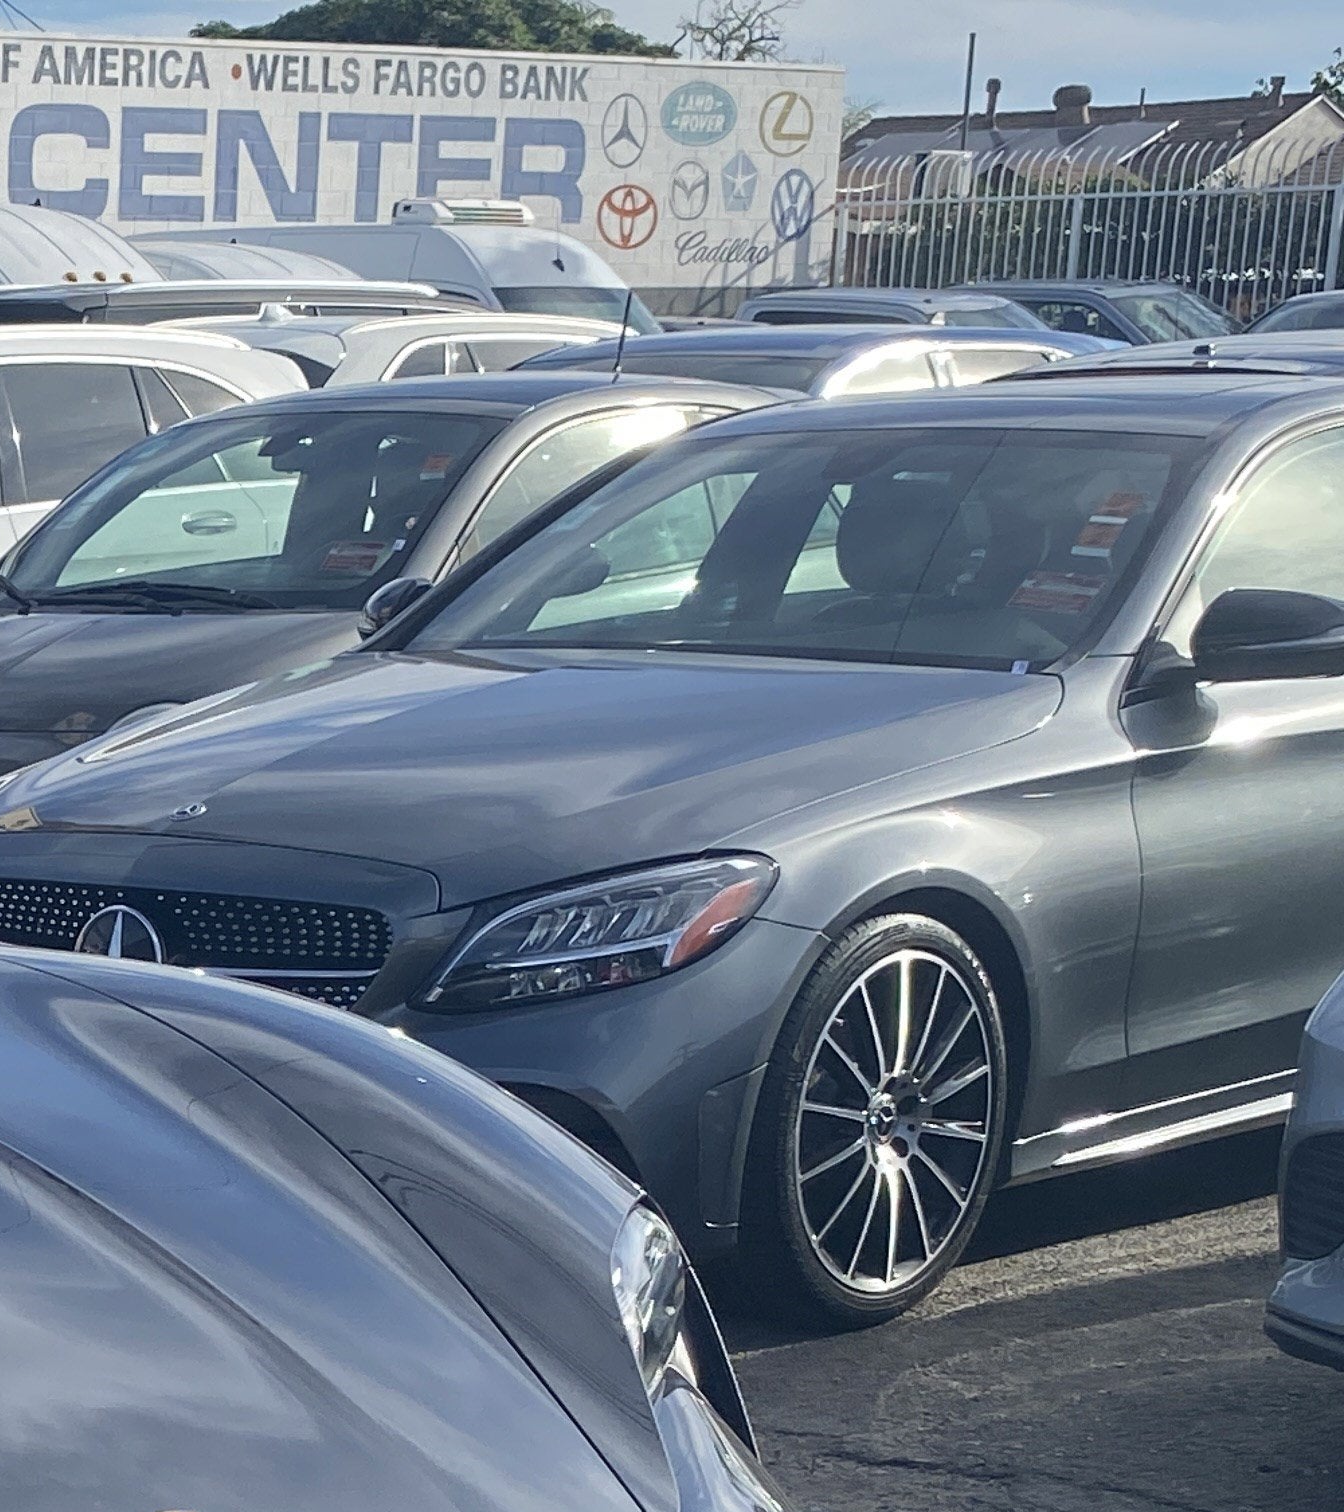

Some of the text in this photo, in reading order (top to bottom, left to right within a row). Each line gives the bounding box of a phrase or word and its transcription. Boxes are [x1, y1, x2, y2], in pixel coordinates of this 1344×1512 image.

[31, 45, 210, 90] AMERICA
[246, 53, 591, 103] WELLS FARGO BANK
[8, 103, 586, 224] CENTER
[675, 230, 770, 265] Cadillac
